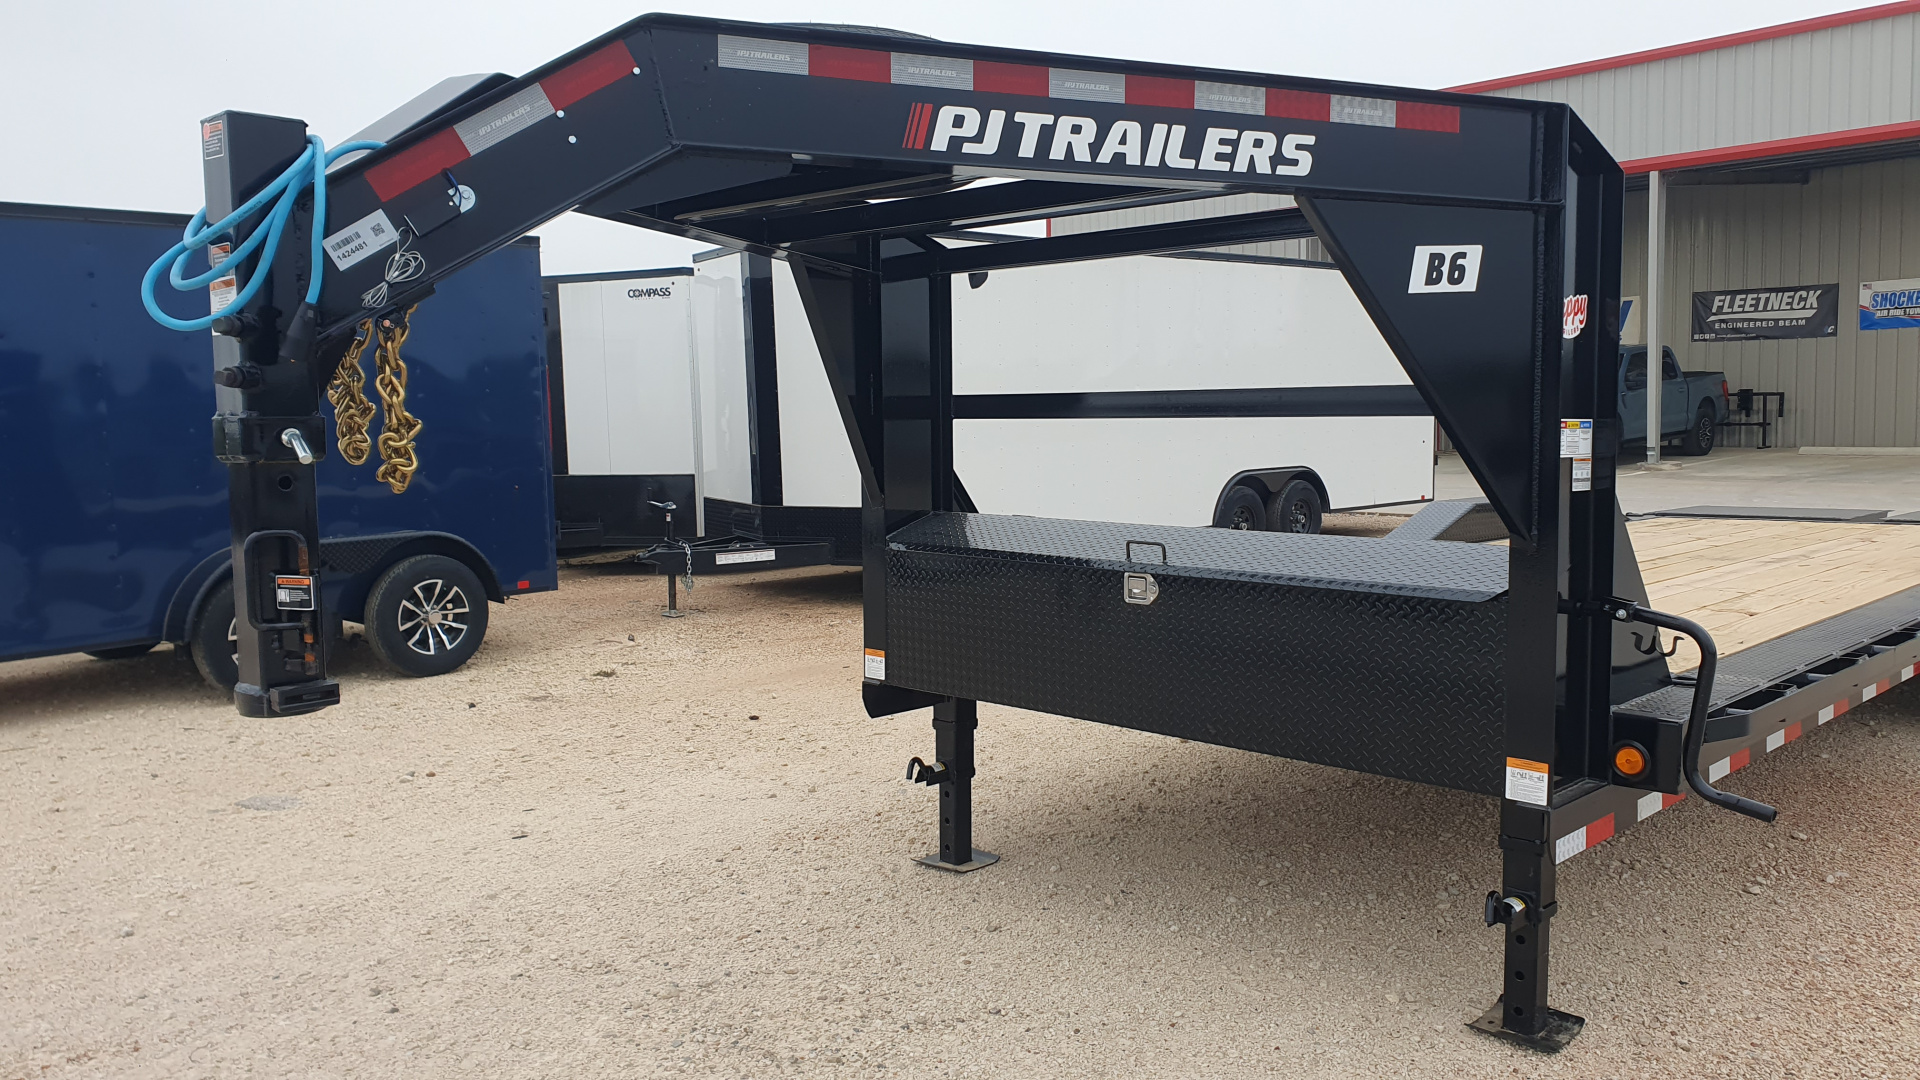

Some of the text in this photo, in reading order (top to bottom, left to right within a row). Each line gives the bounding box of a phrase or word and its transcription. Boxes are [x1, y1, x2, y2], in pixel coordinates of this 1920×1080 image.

[930, 105, 1316, 177] PJ TRAILERS
[336, 240, 369, 262] 1424481
[1424, 251, 1468, 286] B6
[627, 287, 671, 299] COMPASS
[1711, 289, 1823, 313] FLEETNECK
[1563, 296, 1587, 326] ppy
[1888, 308, 1905, 317] RIDE
[1714, 318, 1806, 329] ENGINEERED BEAM
